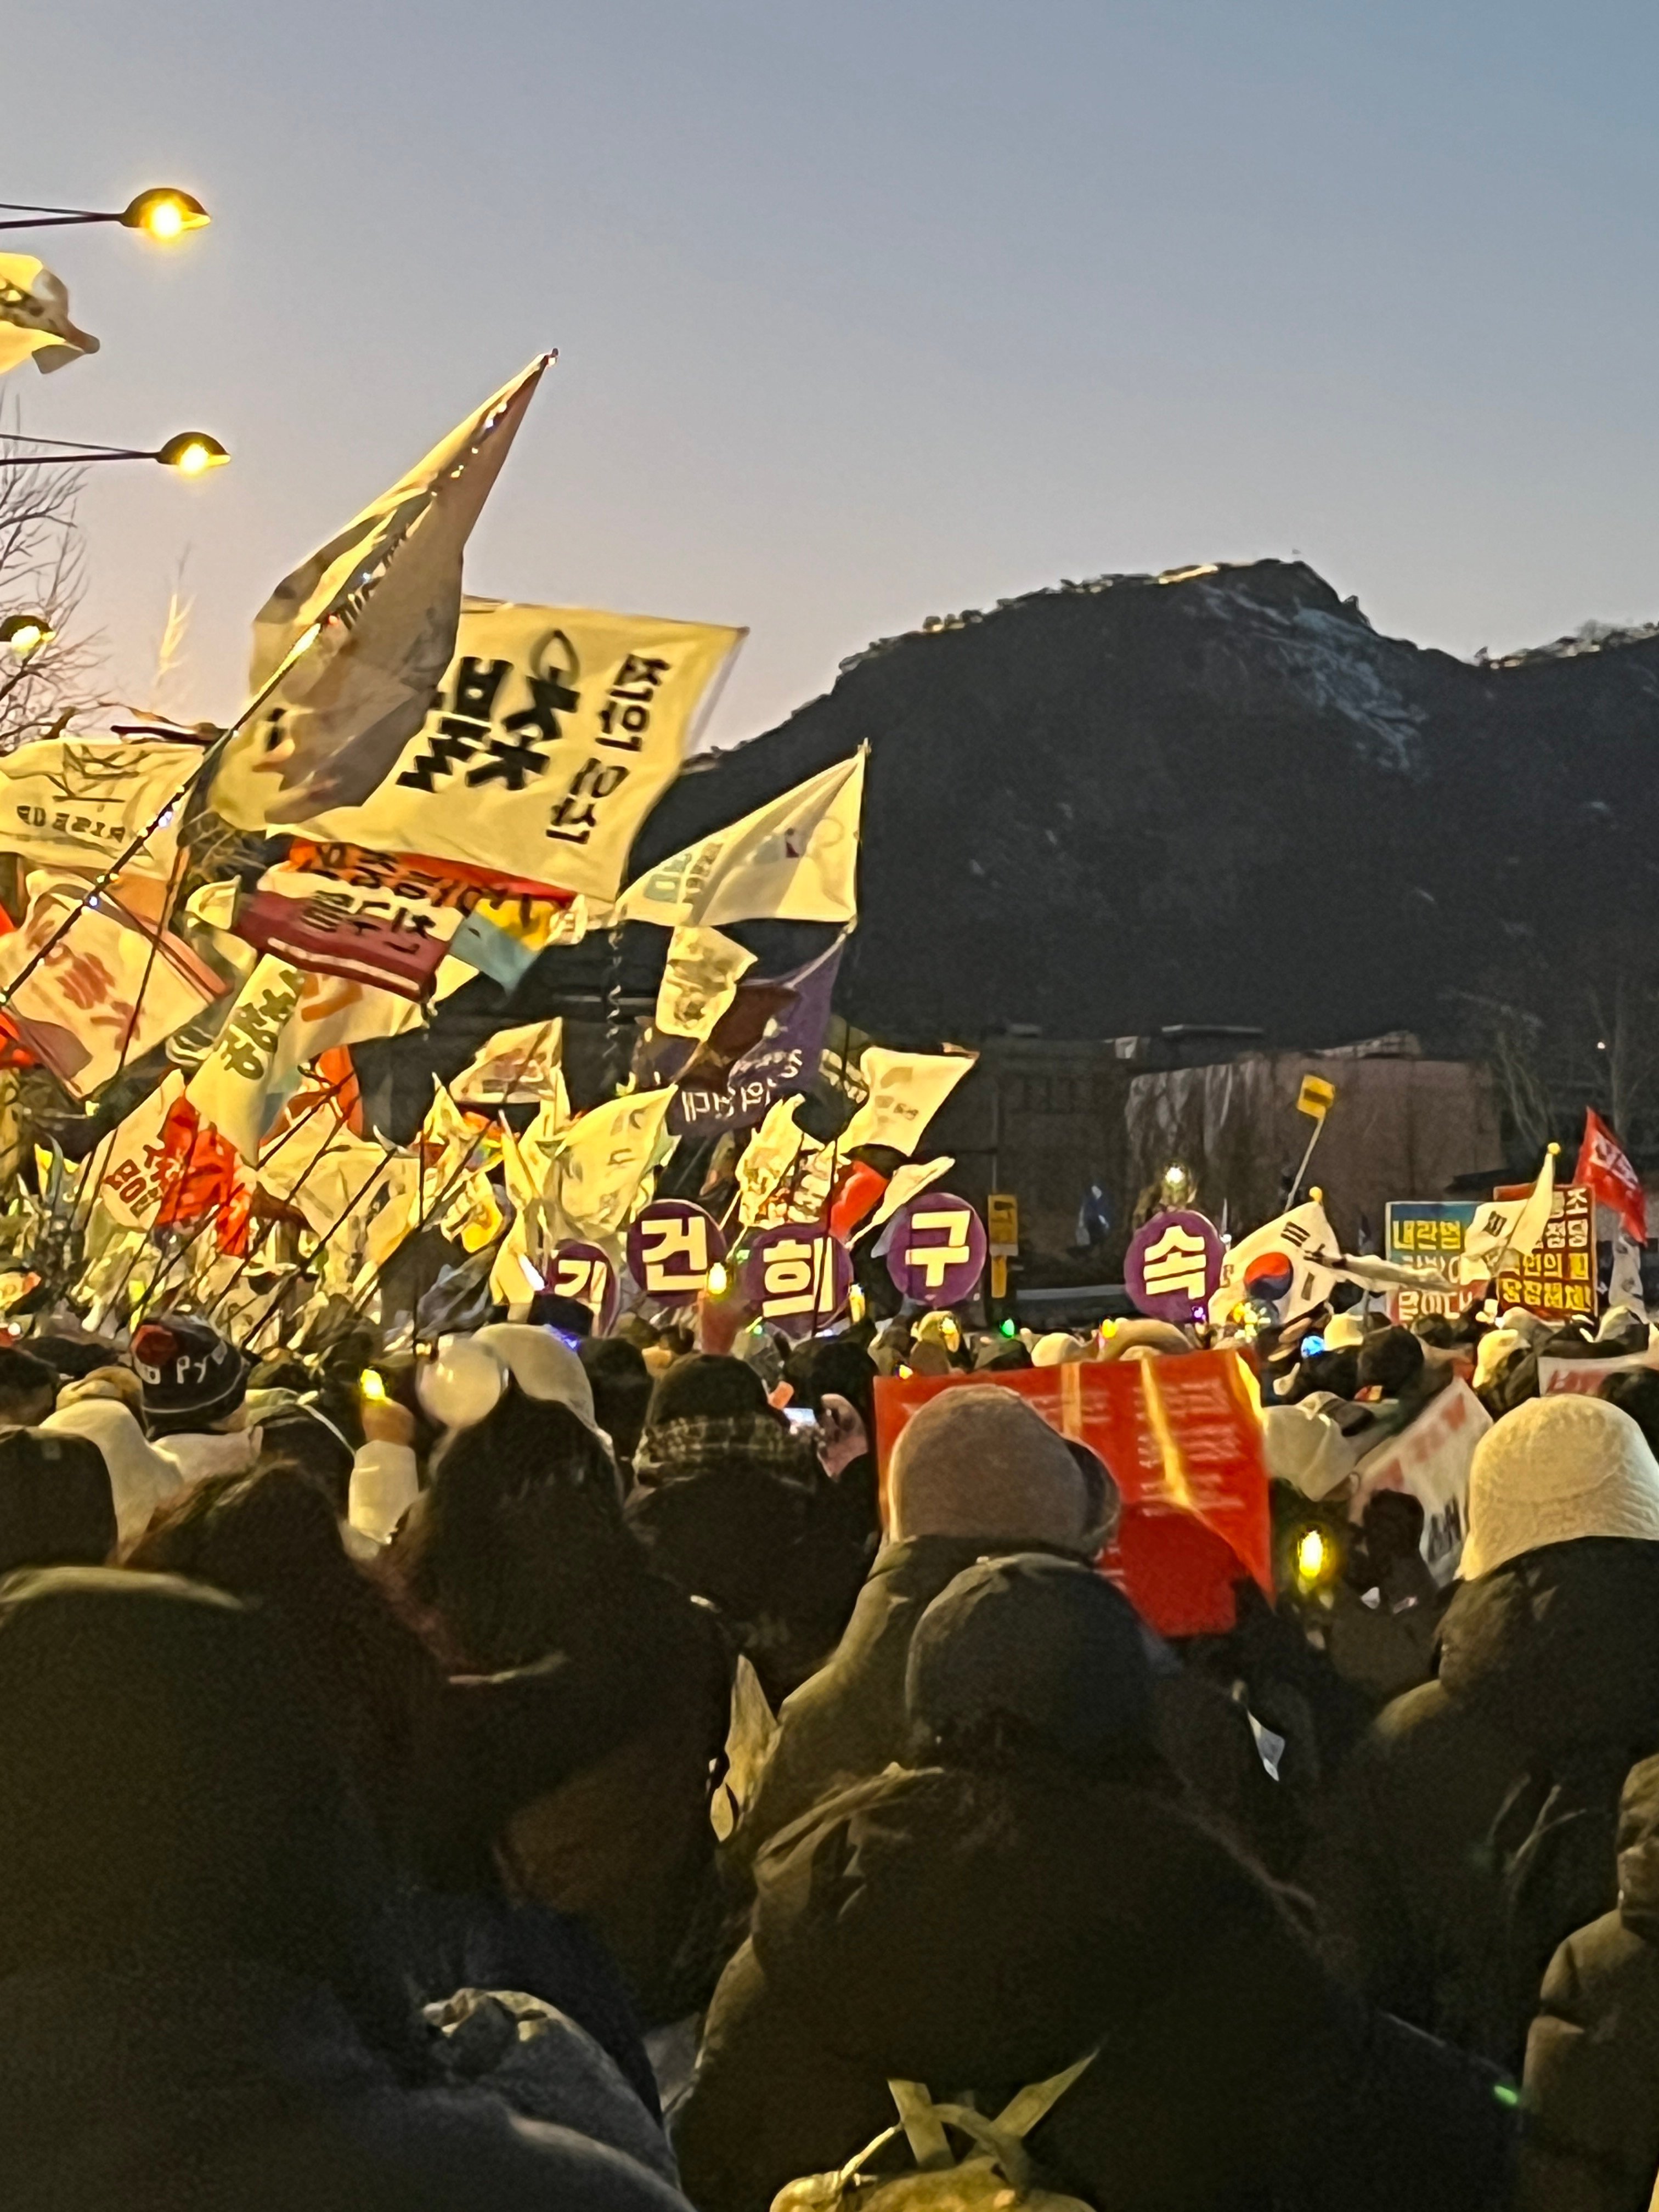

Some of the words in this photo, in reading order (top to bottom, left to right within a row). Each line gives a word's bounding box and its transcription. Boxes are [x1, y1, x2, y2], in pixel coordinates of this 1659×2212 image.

[641, 1216, 708, 1291] 건
[762, 1237, 833, 1318] 희
[905, 1210, 970, 1287] 구
[1143, 1224, 1207, 1300] 속
